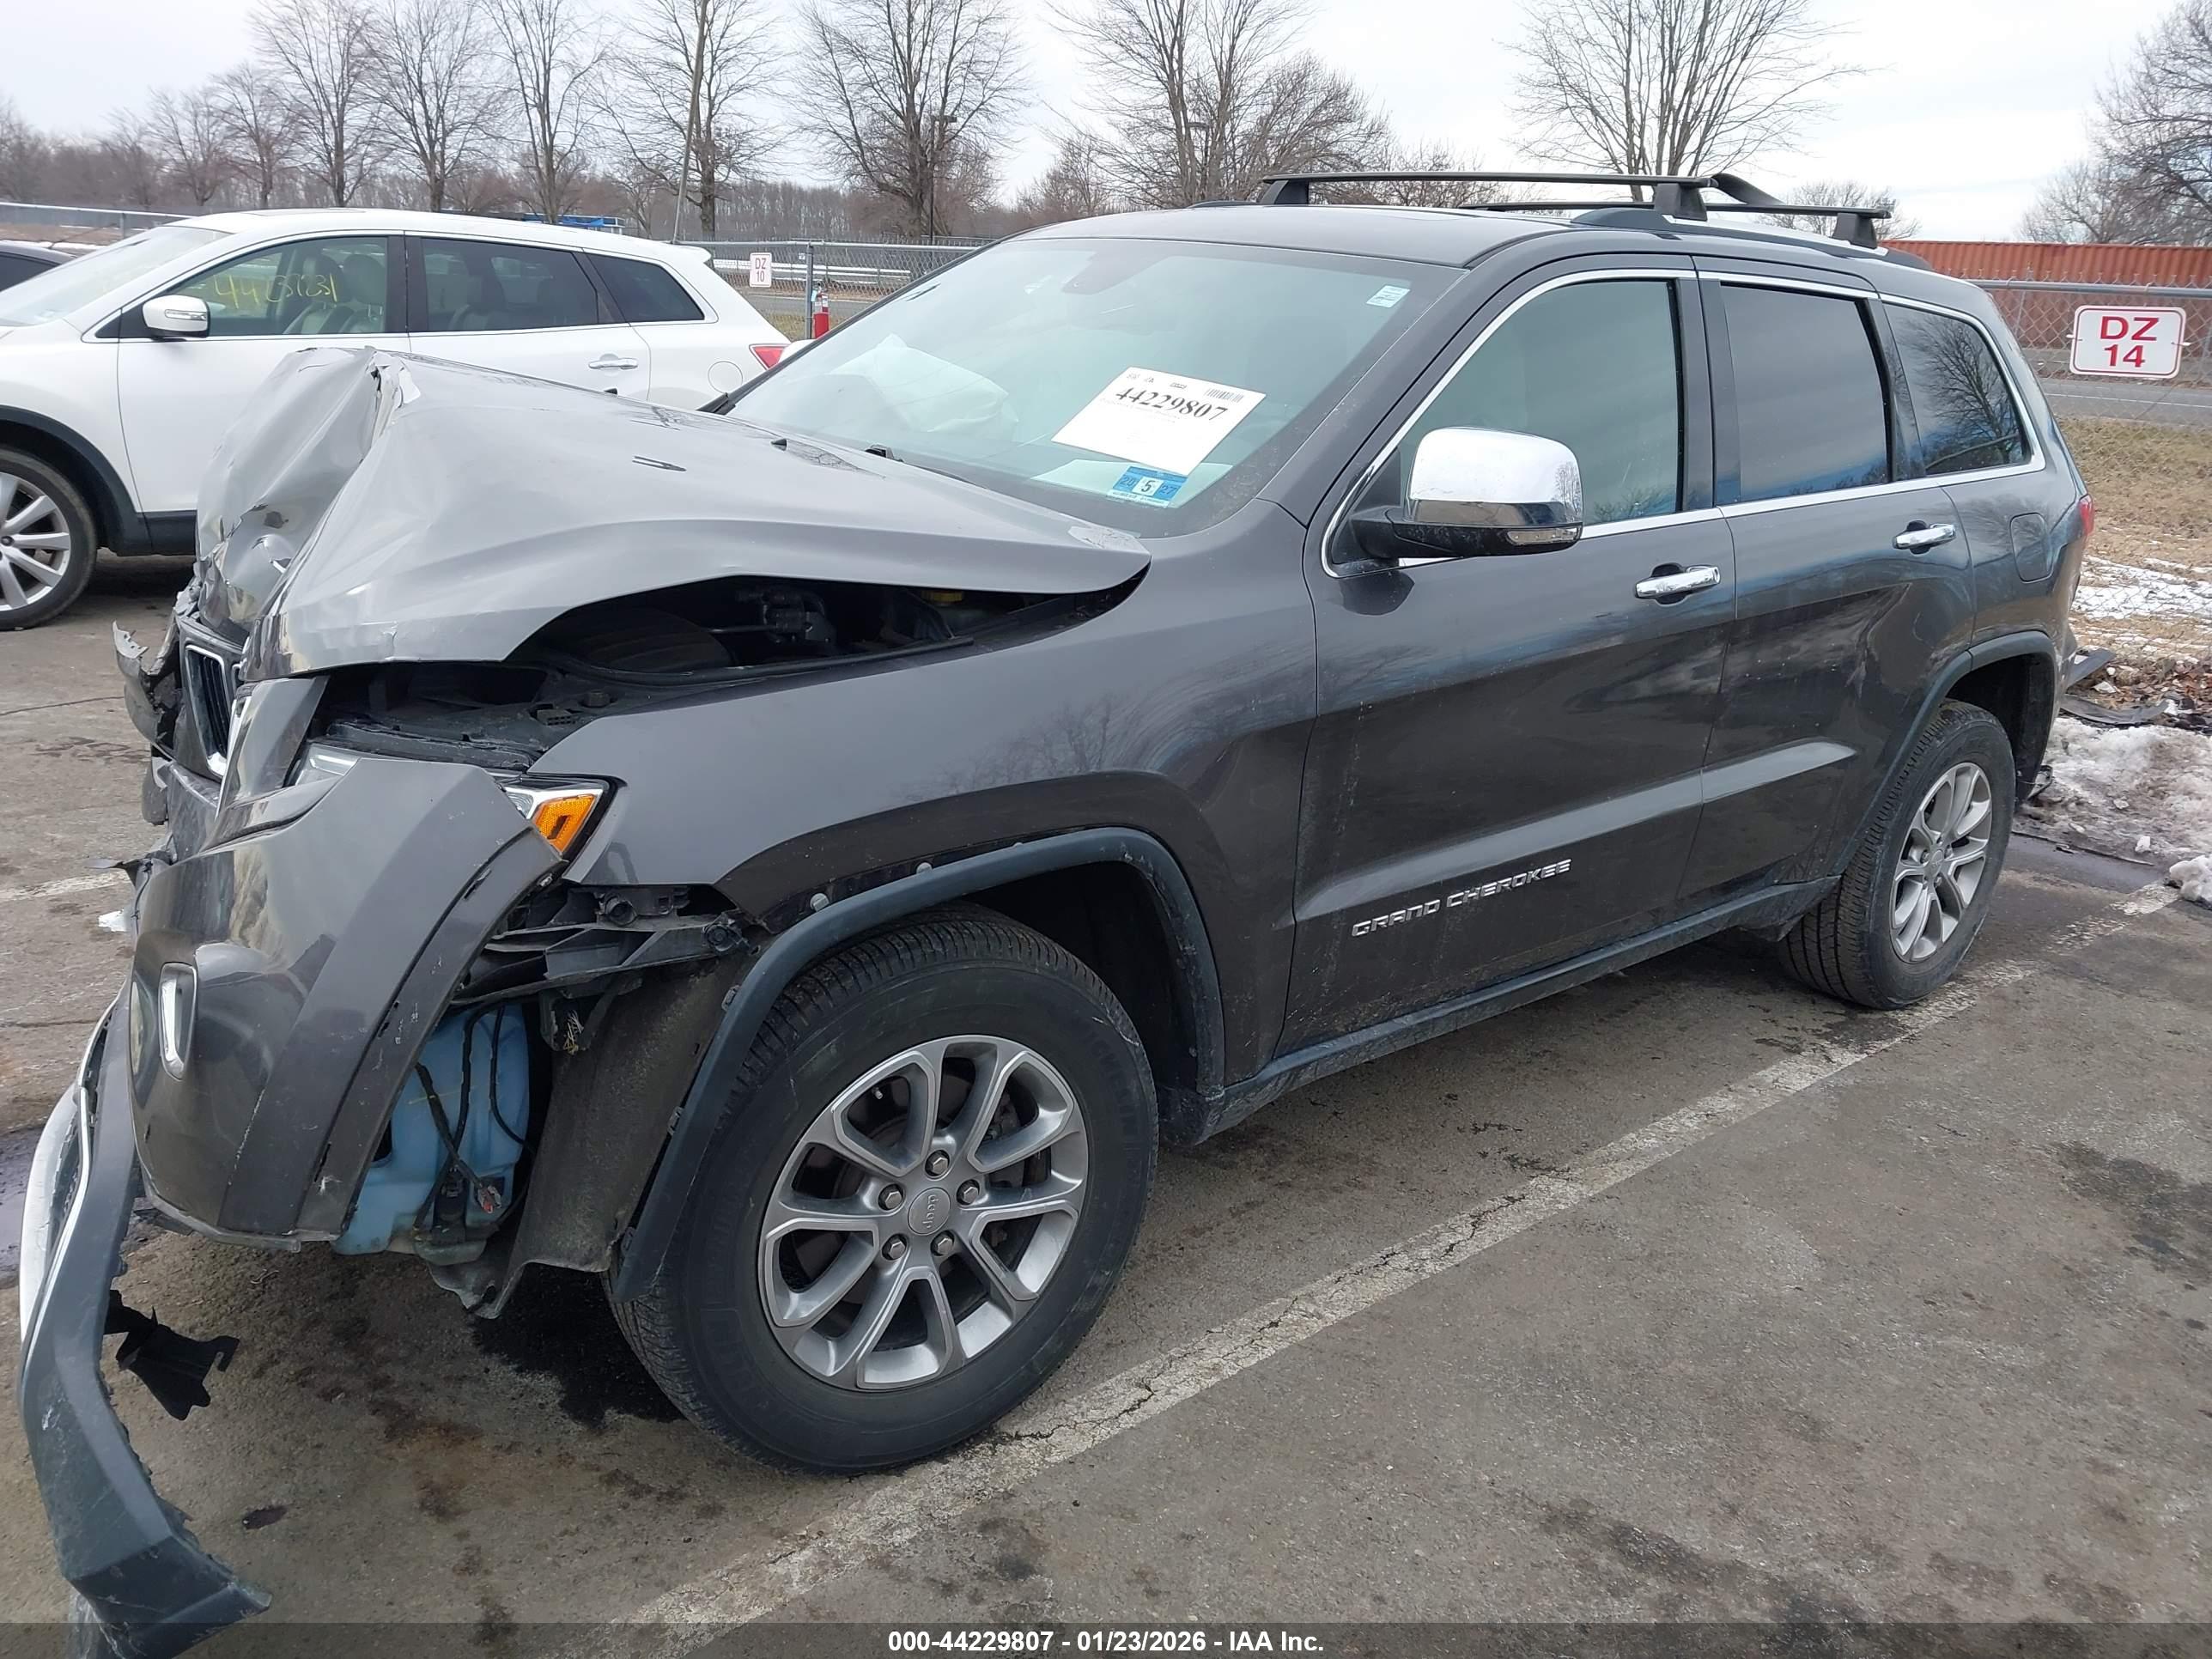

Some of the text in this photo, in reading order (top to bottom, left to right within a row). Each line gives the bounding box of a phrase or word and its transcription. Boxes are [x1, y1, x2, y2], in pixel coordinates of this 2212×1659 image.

[755, 257, 767, 270] DZ
[756, 270, 765, 283] 10
[2100, 315, 2160, 341] DZ
[2103, 343, 2146, 368] 14
[1115, 386, 1229, 421] 44229807
[1140, 479, 1156, 493] 5
[1351, 858, 1572, 938] GRAND CHEROKEE
[922, 1194, 939, 1229] Jeep
